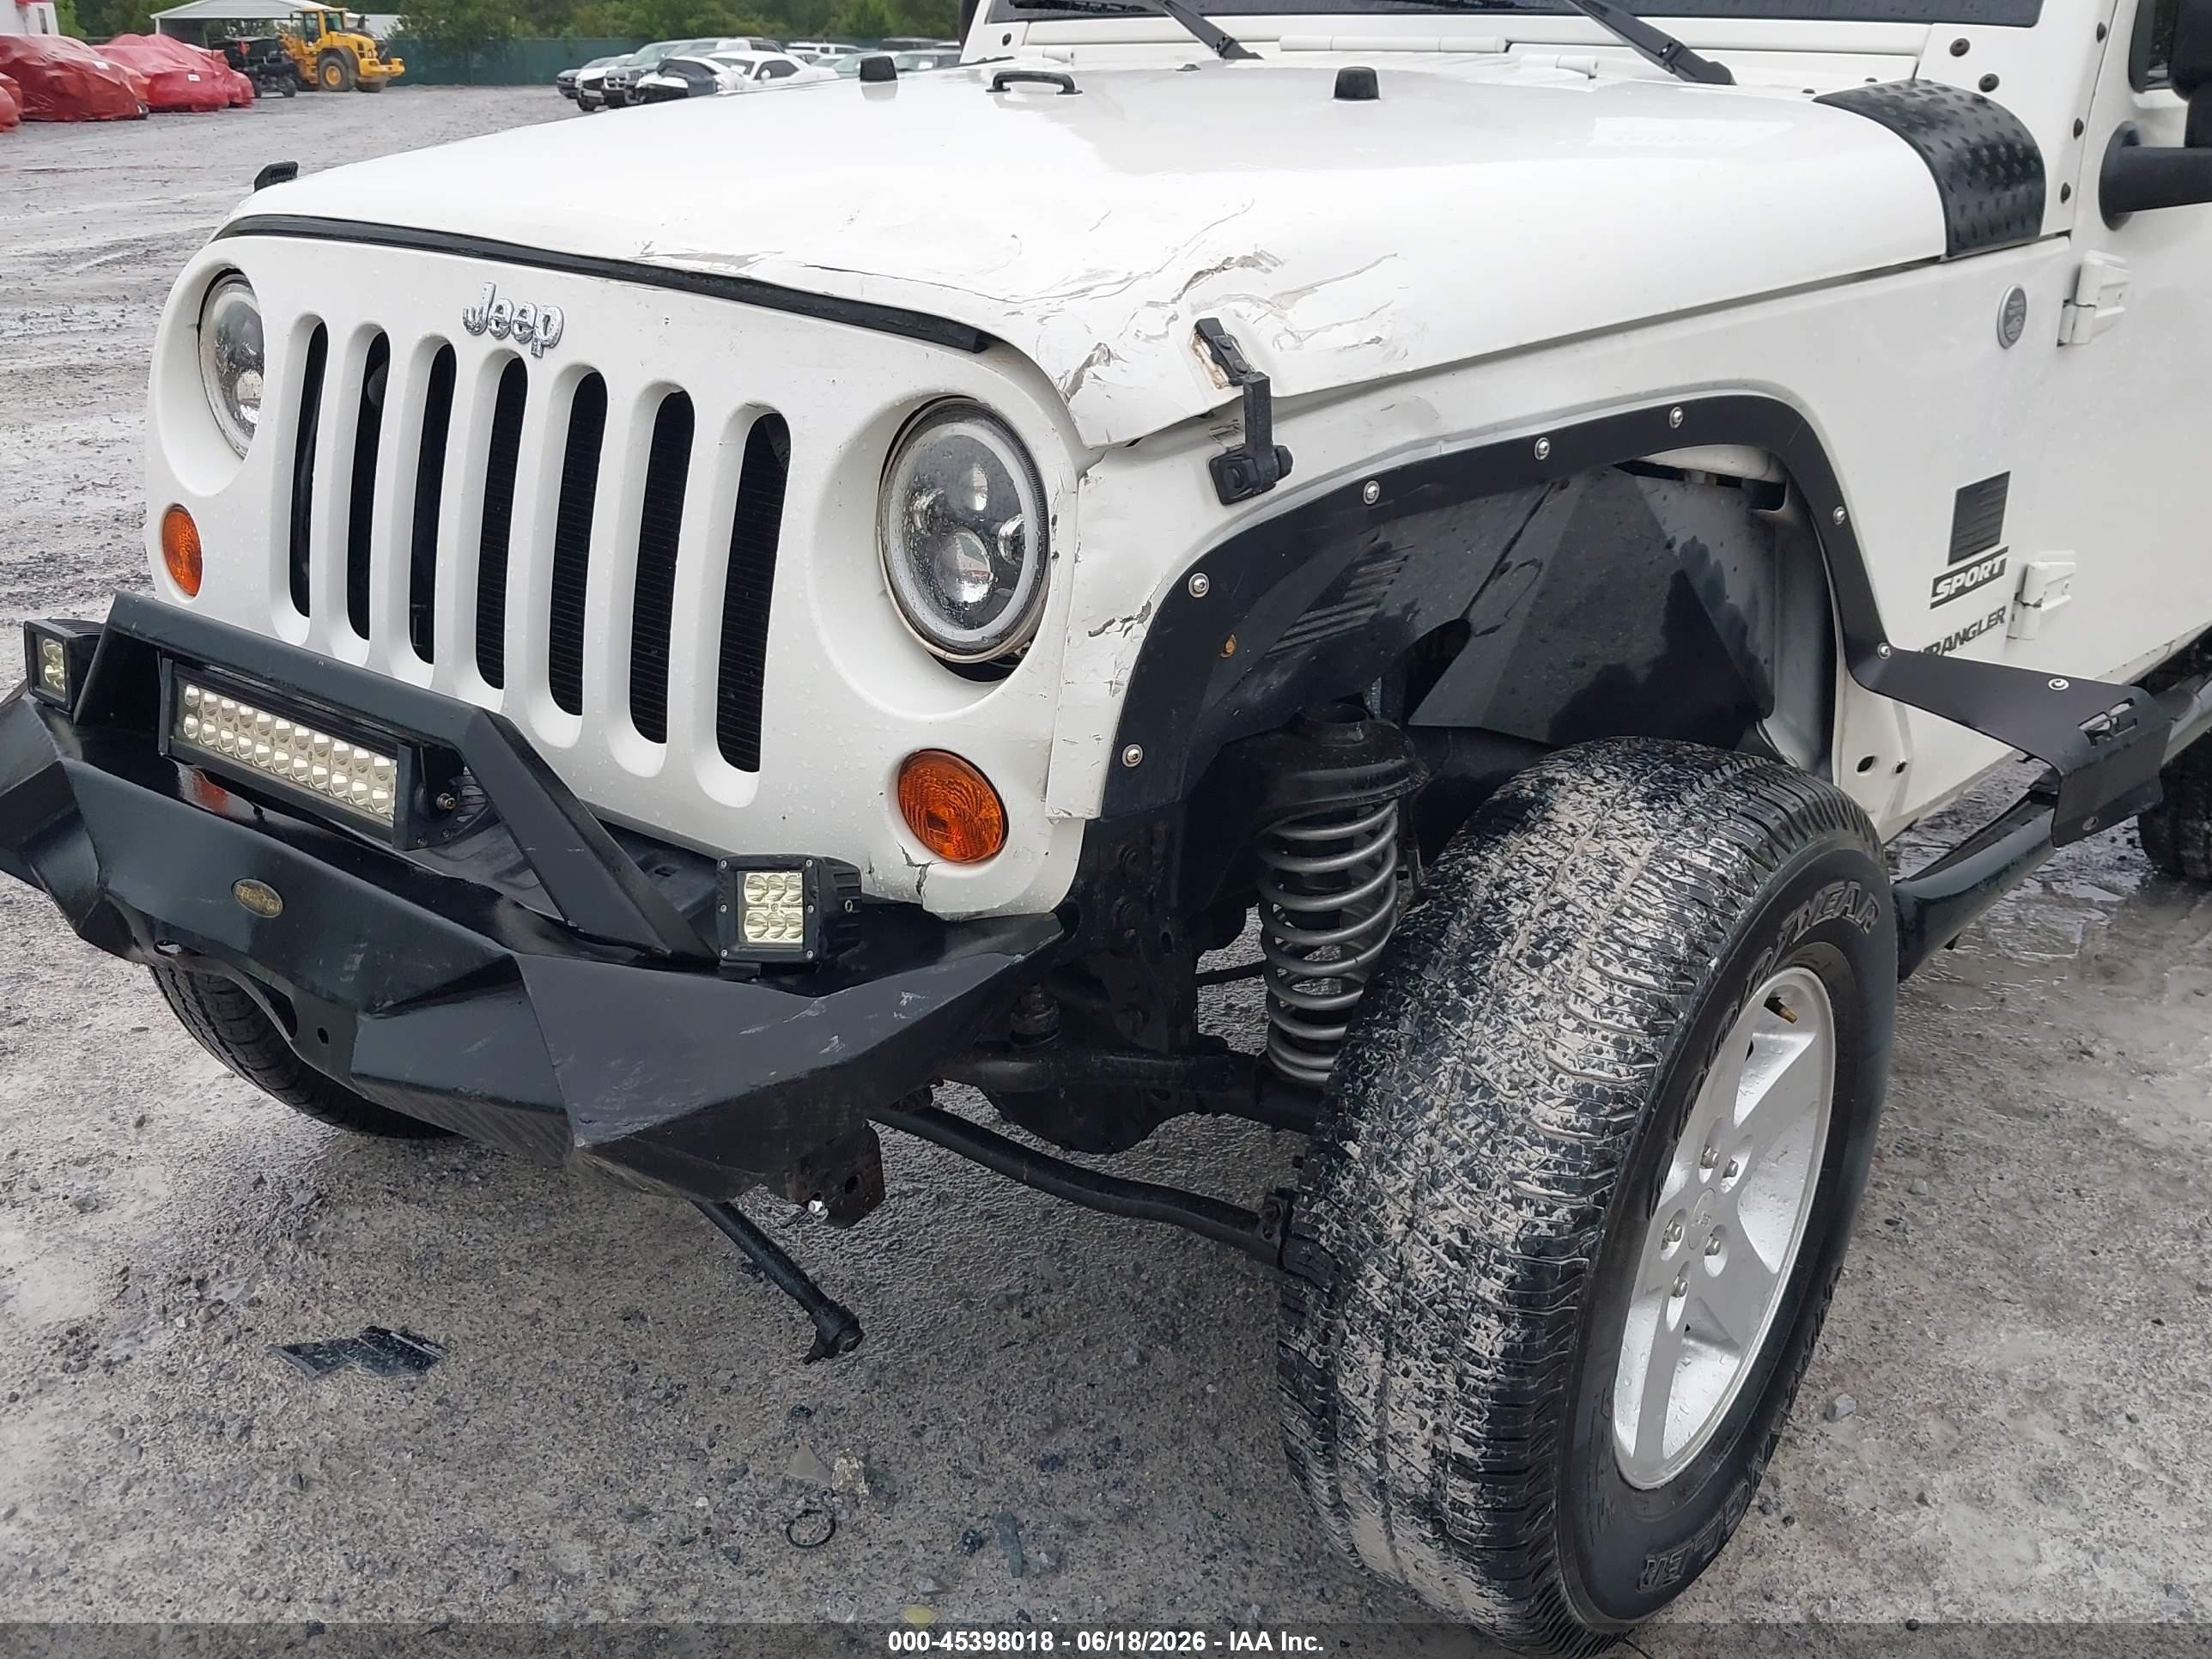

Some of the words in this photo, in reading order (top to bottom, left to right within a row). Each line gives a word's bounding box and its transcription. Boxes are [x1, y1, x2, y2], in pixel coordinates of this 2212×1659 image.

[462, 282, 564, 358] Jeep
[1930, 552, 2008, 604] SPORT
[1917, 605, 2007, 656] RANGLER
